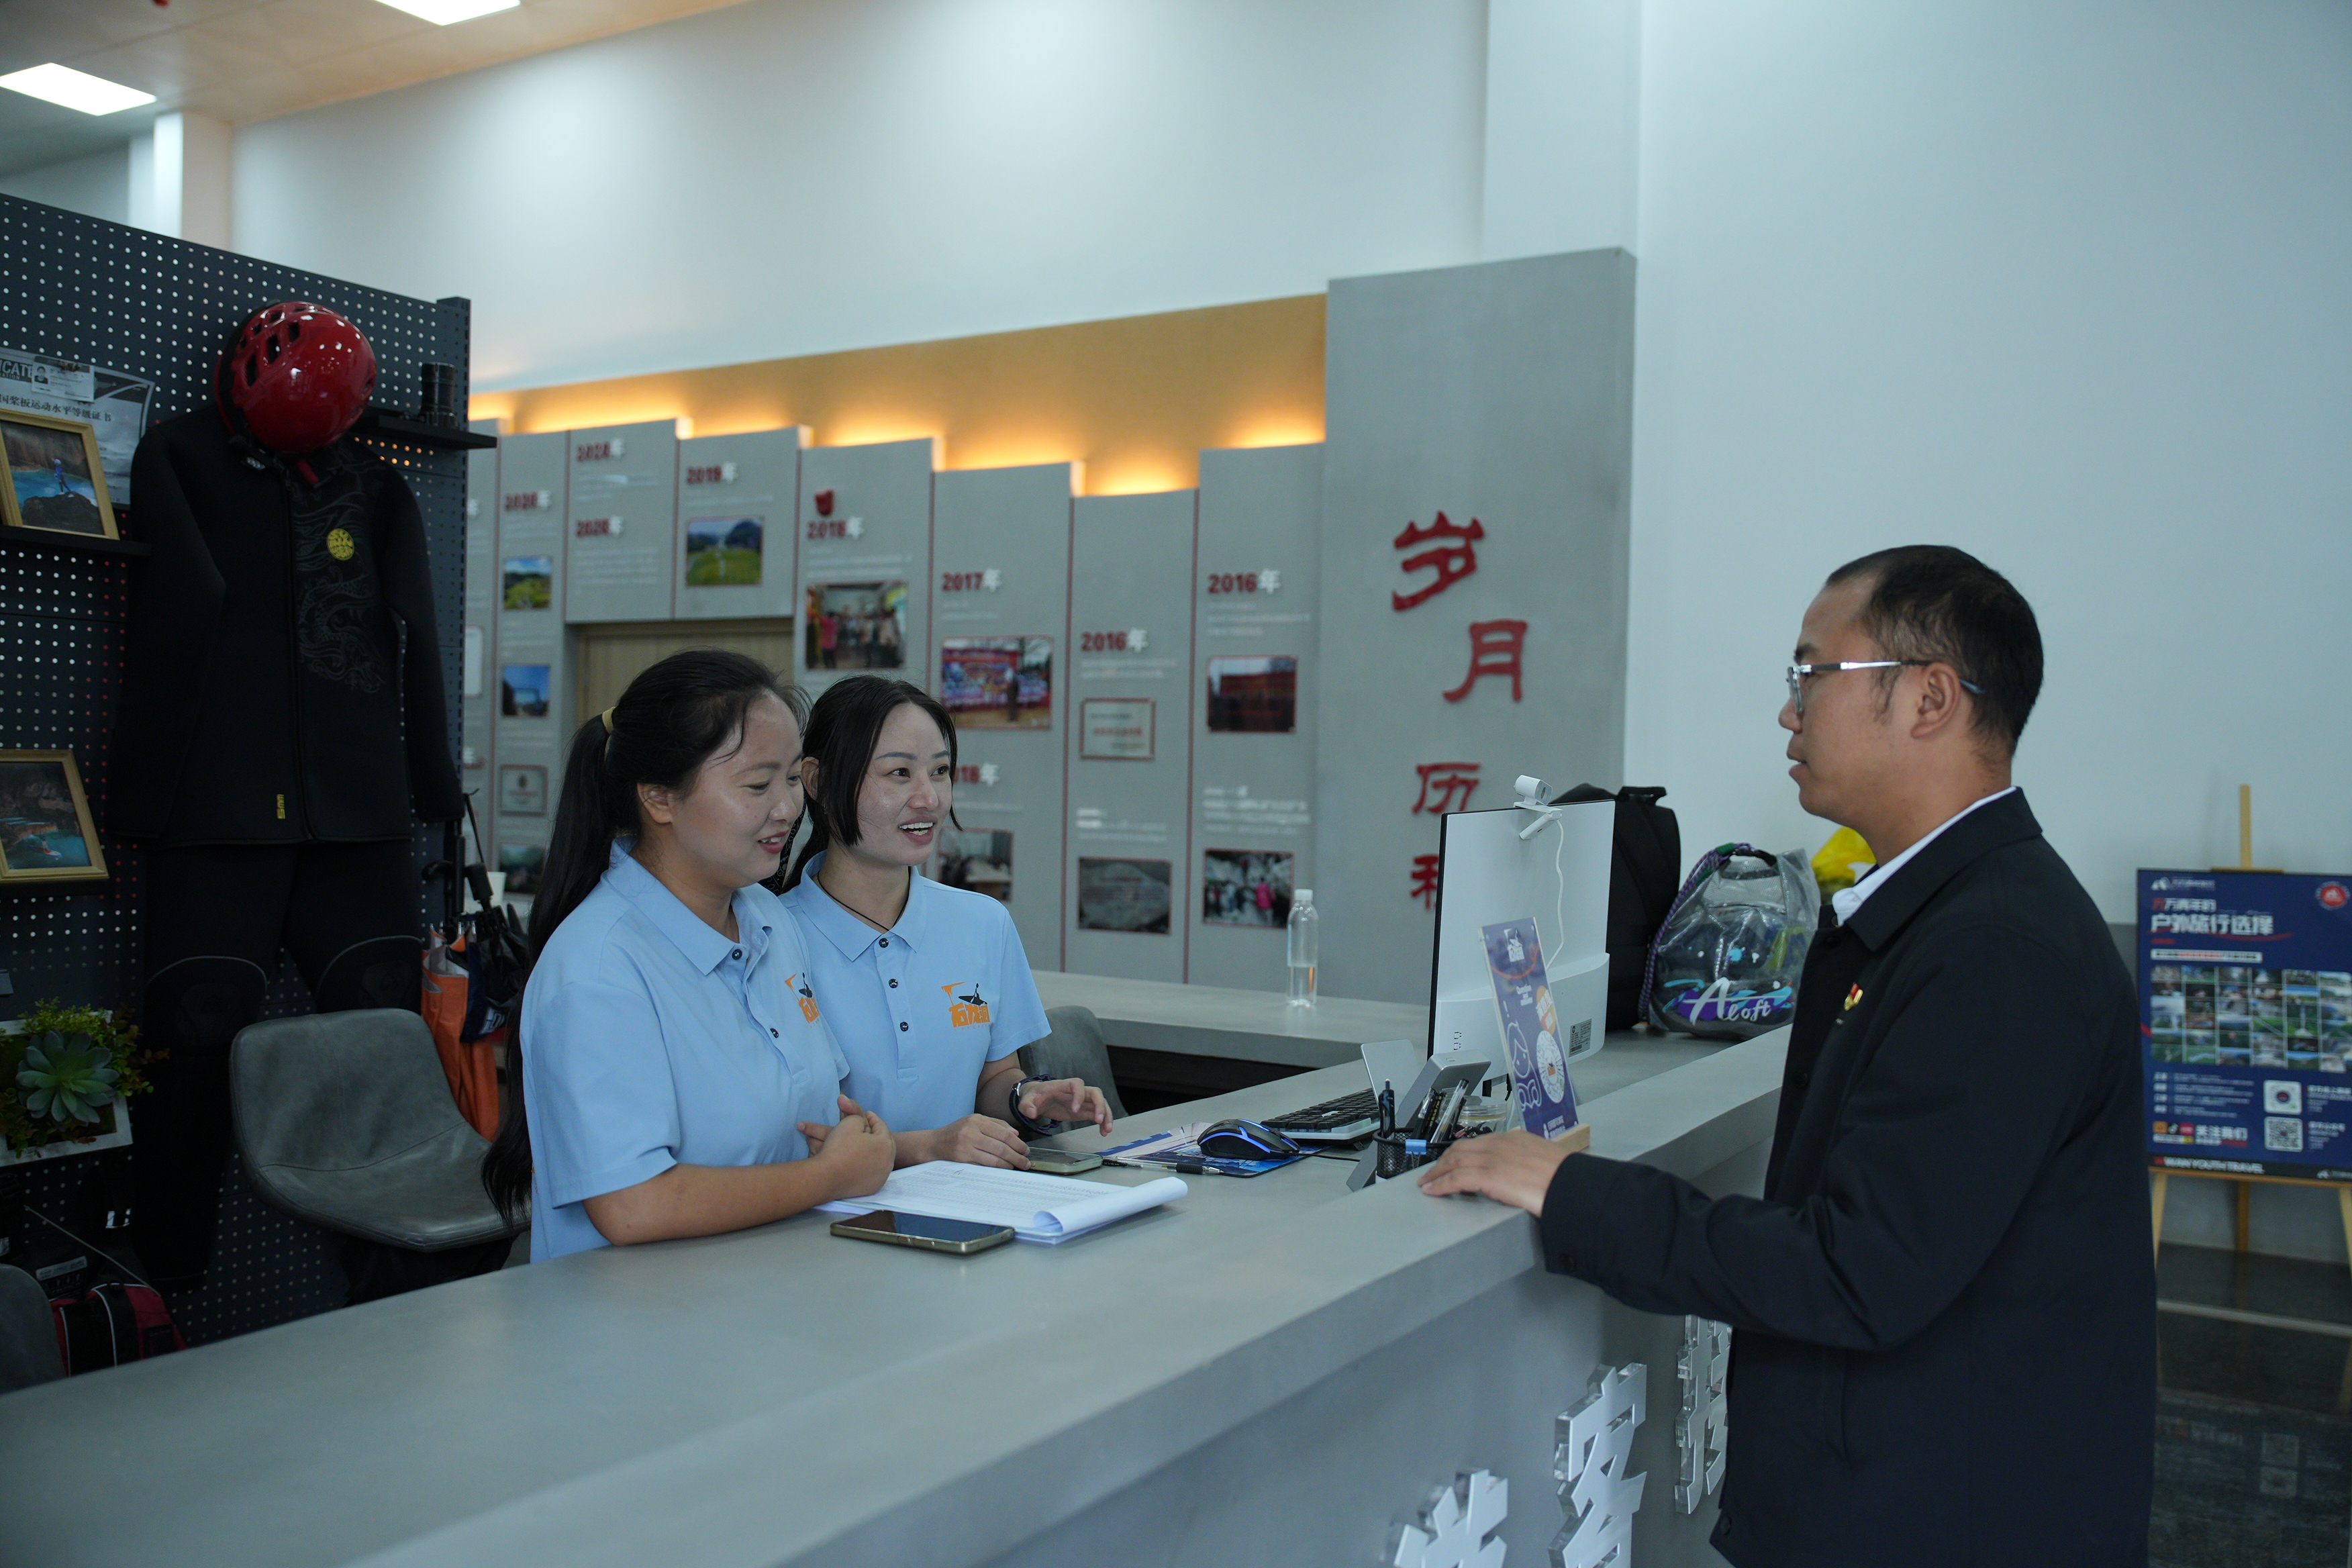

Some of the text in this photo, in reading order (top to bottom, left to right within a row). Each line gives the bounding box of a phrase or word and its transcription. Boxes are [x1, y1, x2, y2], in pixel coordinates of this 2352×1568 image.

[941, 568, 1002, 593] 2017年
[1207, 567, 1281, 595] 2016年
[1081, 628, 1148, 653] 2016年
[1683, 977, 1787, 1026] Aloft
